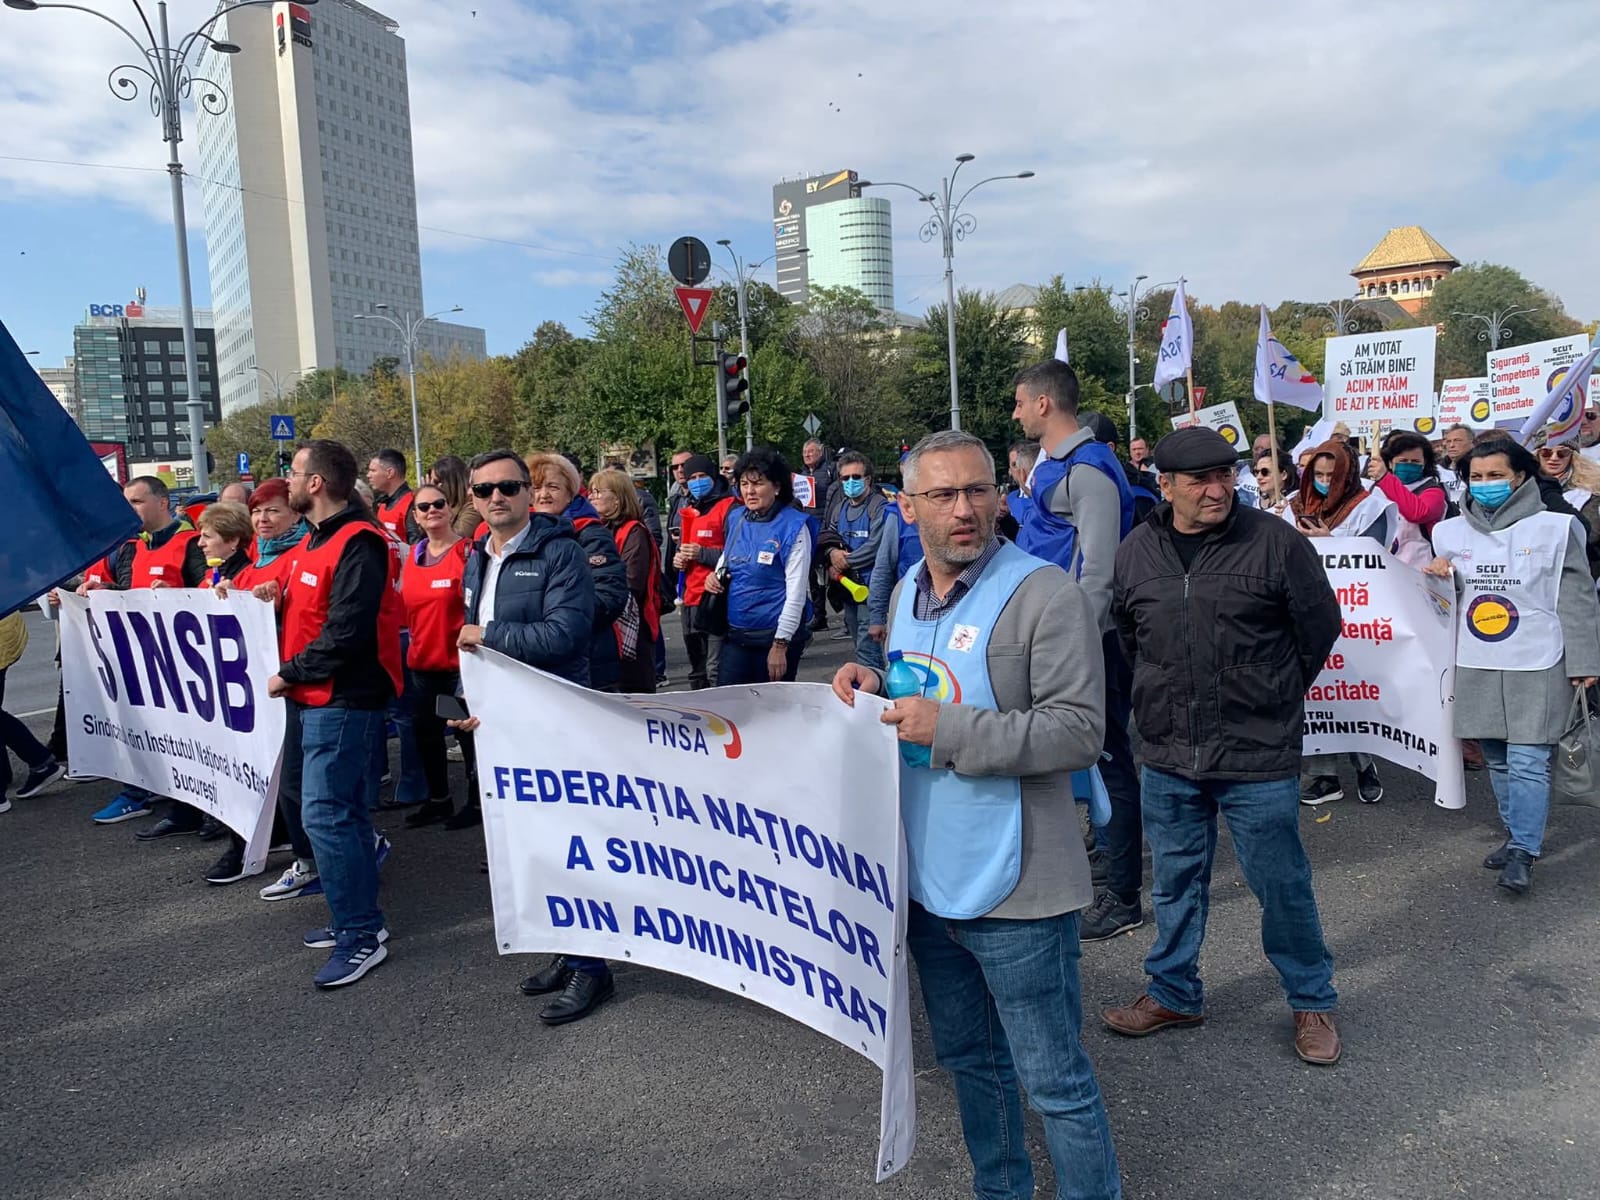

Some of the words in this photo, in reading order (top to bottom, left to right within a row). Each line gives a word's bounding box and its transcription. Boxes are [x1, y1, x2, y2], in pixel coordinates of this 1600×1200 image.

[806, 180, 820, 194] EY
[90, 304, 124, 317] BCR
[1355, 343, 1370, 358] AM
[1373, 340, 1402, 356] VOTAT
[1552, 344, 1573, 354] SCUT
[1340, 359, 1353, 376] SĂ
[1355, 358, 1386, 375] TRĂIM
[1388, 357, 1416, 373] BINE!
[1490, 352, 1530, 370] Siguranță
[1491, 365, 1540, 384] Competență
[1346, 379, 1374, 394] ACUM
[1376, 374, 1408, 391] TRĂIM
[1491, 385, 1520, 398] Unitate
[1335, 397, 1347, 411] DE
[1350, 396, 1365, 410] AZI
[1367, 395, 1380, 410] PE
[1382, 392, 1419, 409] MÂINE!
[1491, 398, 1534, 413] Tenacitate
[240, 453, 247, 471] P
[1476, 565, 1506, 574] SCUT
[85, 608, 255, 733] SINSB
[1322, 653, 1345, 671] te
[145, 730, 196, 761] Institutul
[646, 718, 710, 756] FNSA
[493, 766, 701, 826] FEDERAȚIA
[546, 895, 620, 933] DIN
[566, 835, 594, 872] A
[607, 837, 888, 980] SINDICATELOR
